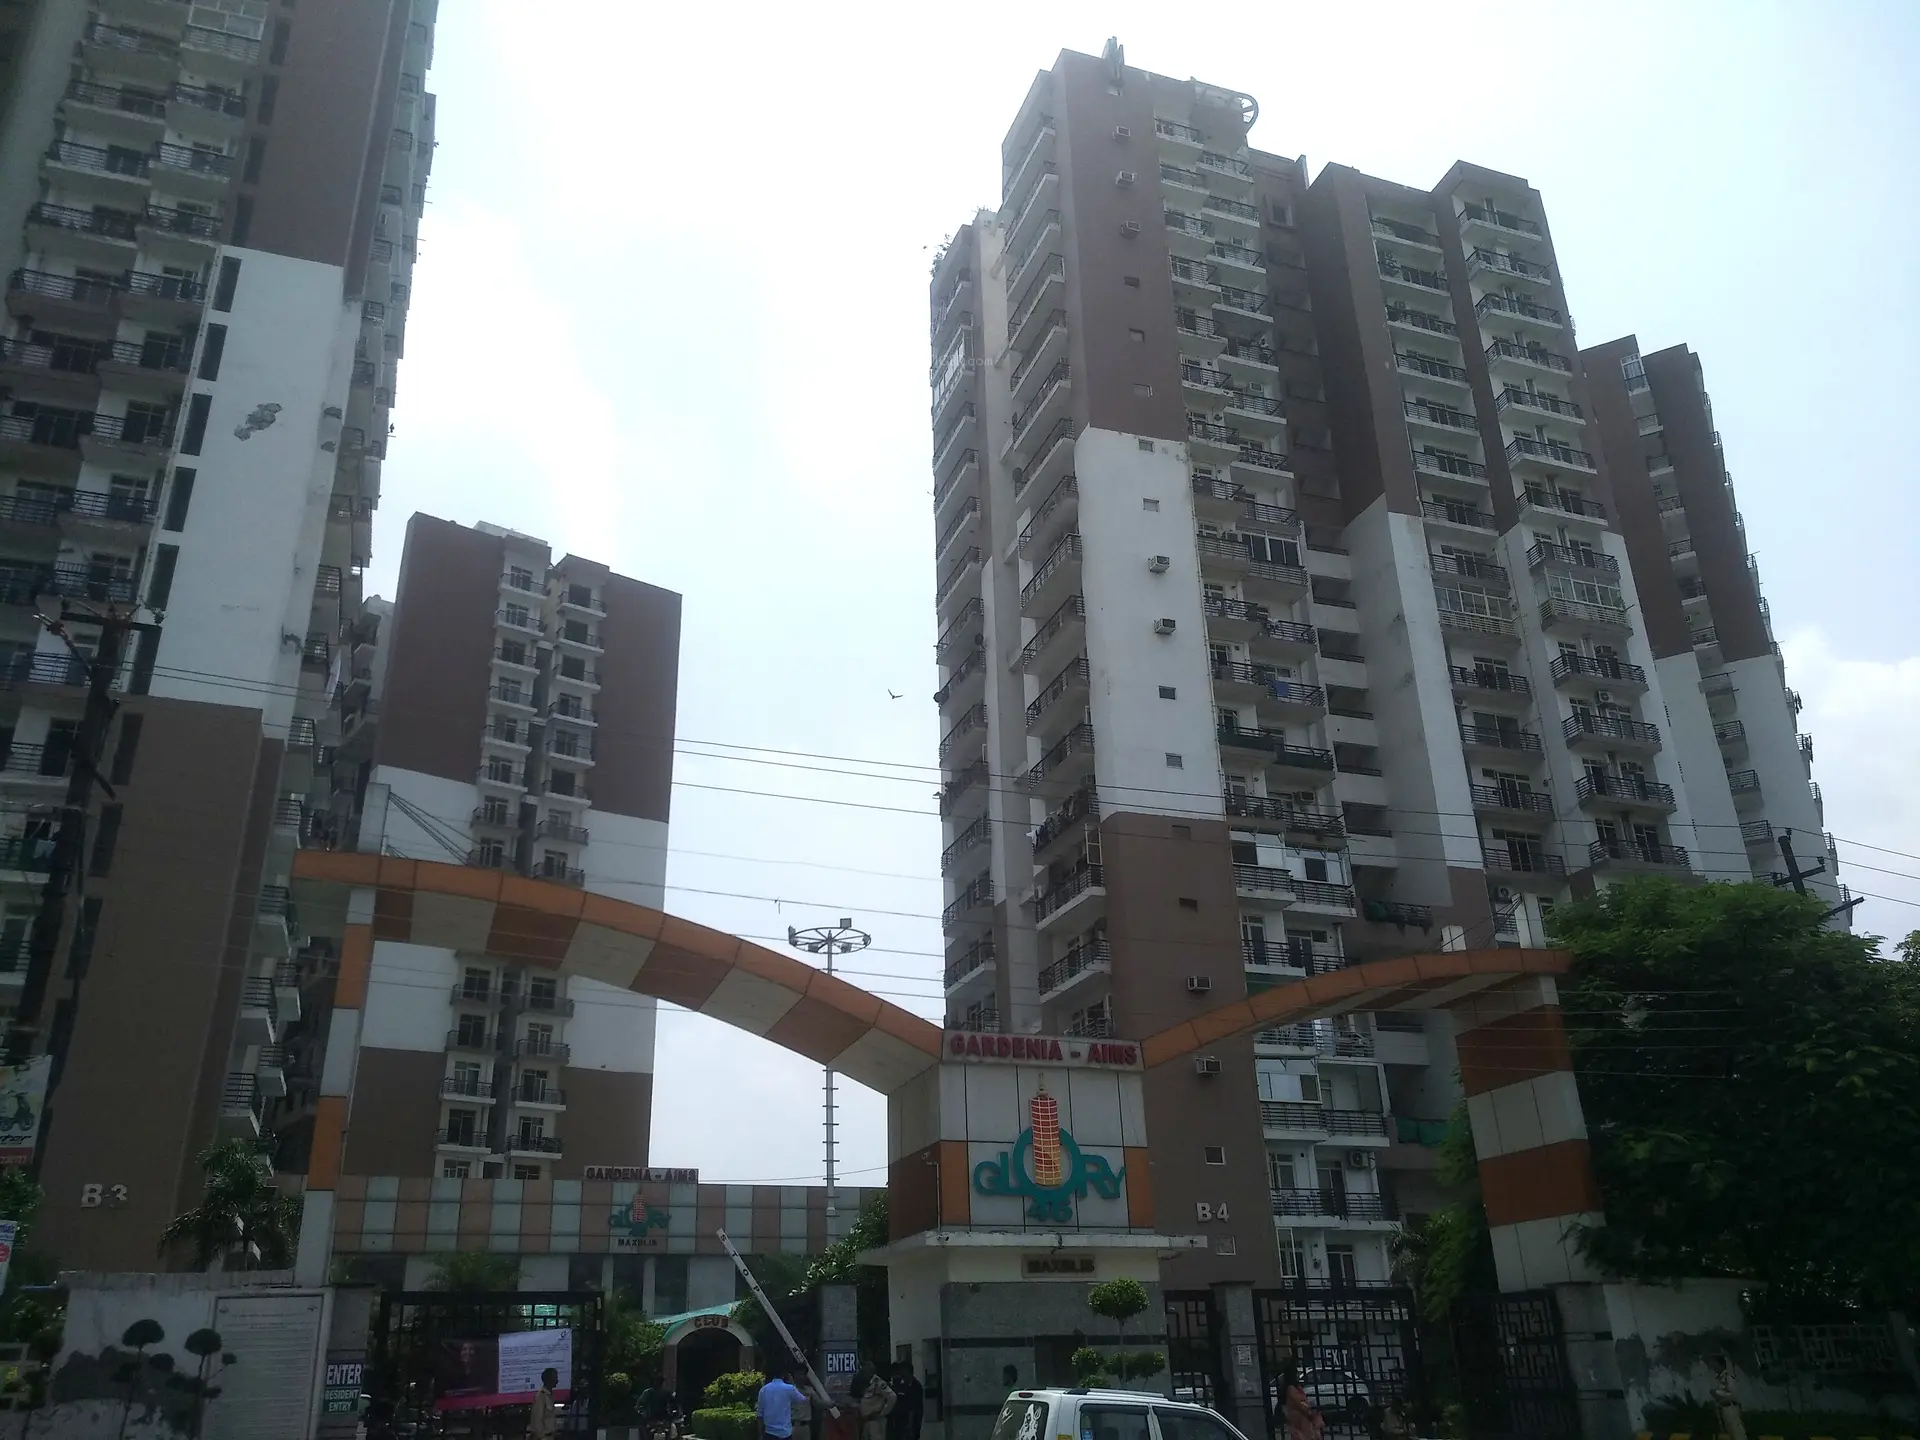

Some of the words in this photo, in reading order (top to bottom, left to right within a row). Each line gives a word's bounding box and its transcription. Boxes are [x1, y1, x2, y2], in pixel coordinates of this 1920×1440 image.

[950, 1033, 1063, 1060] GARDENIA
[1087, 1043, 1138, 1065] AIMS
[585, 1166, 652, 1181] GARDENIA
[663, 1168, 697, 1182] AIMS
[720, 1233, 761, 1292] STOP
[827, 1353, 856, 1371] ENTER
[326, 1364, 362, 1385] ENTER
[324, 1389, 360, 1400] RESIDENT
[328, 1401, 353, 1412] ENTRY
